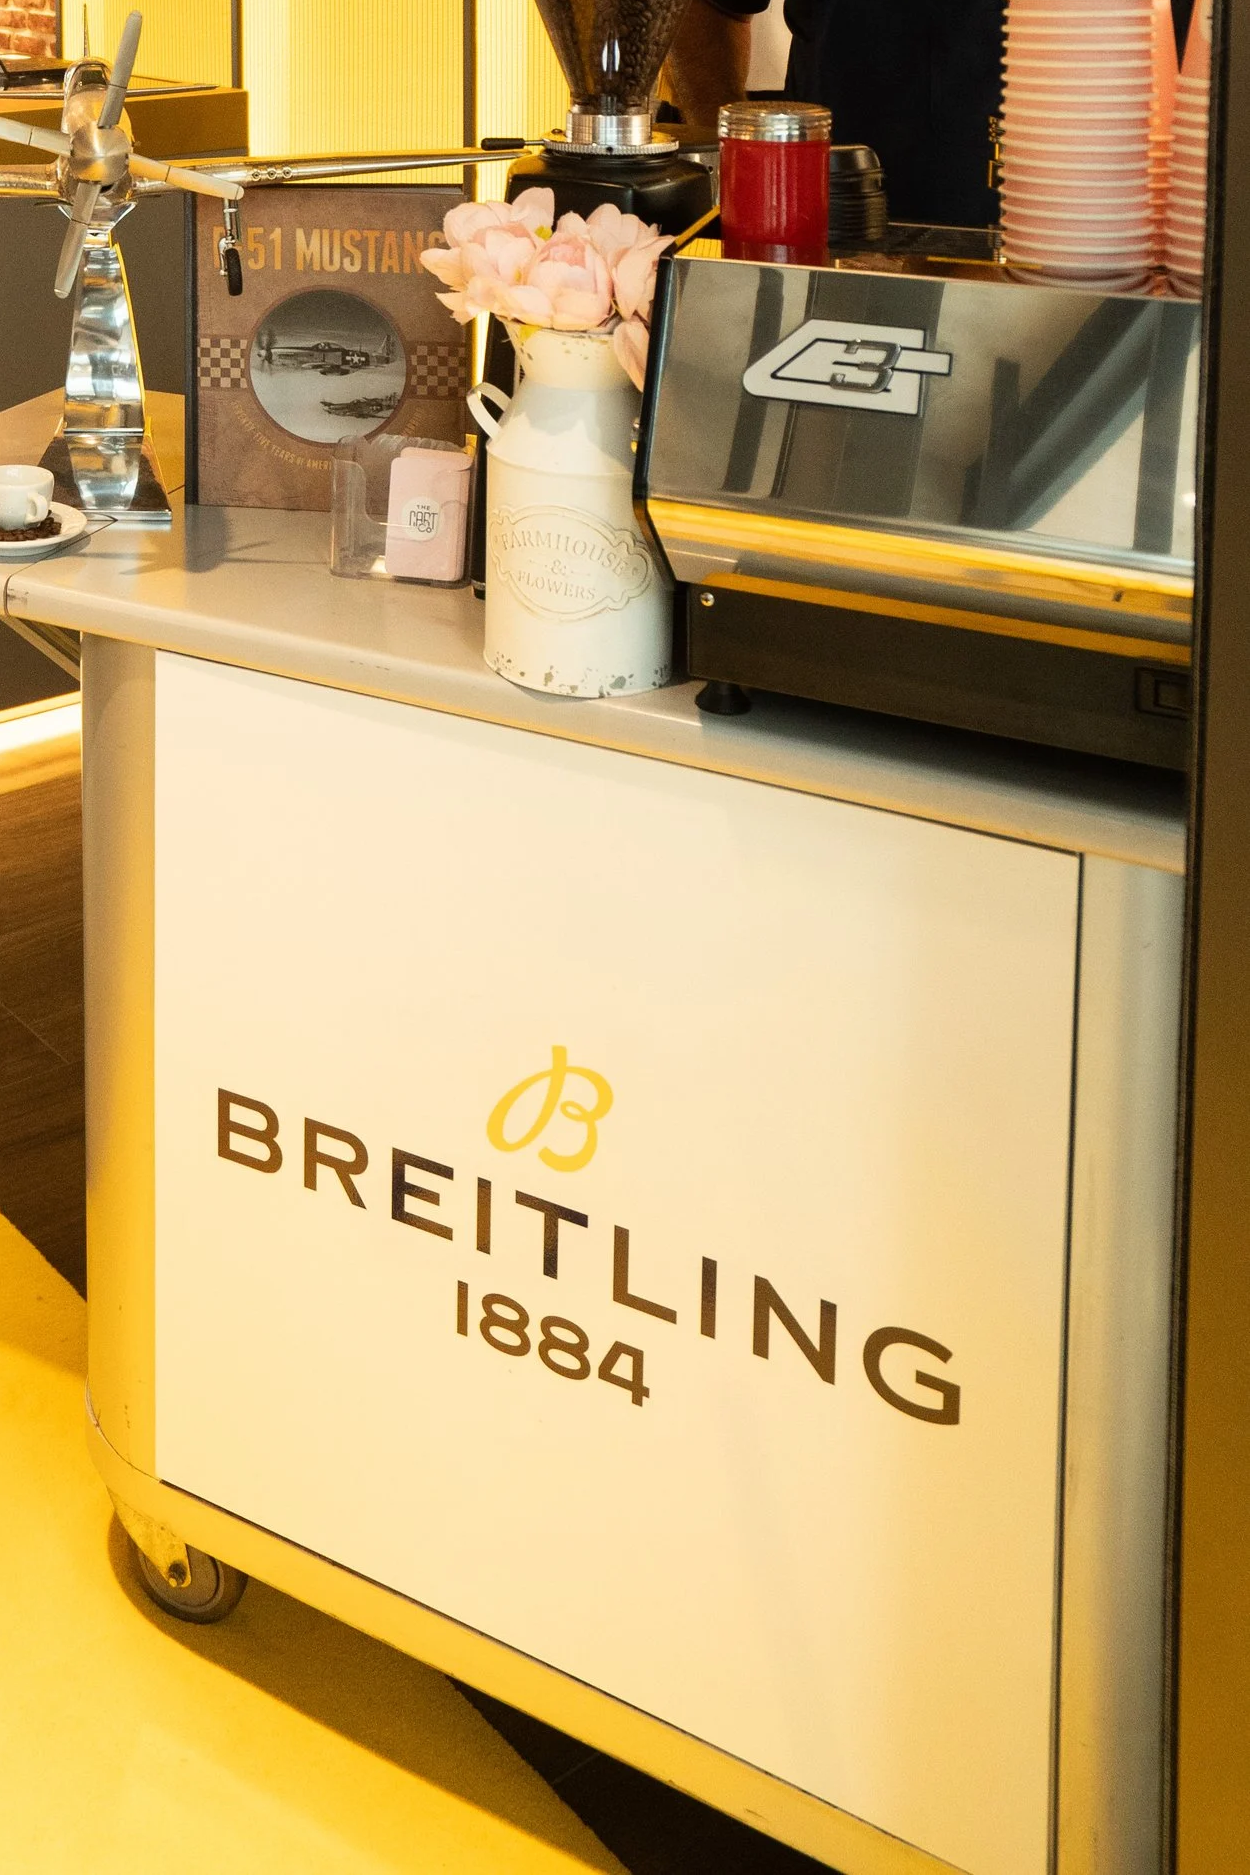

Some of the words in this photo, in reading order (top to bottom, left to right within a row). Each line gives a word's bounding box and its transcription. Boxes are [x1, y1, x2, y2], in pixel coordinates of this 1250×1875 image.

[409, 510, 438, 530] CART
[501, 529, 628, 576] FARMHOUSE
[517, 570, 596, 601] FLOWERS
[218, 1087, 961, 1426] BREITLING
[457, 1280, 650, 1407] 1884
